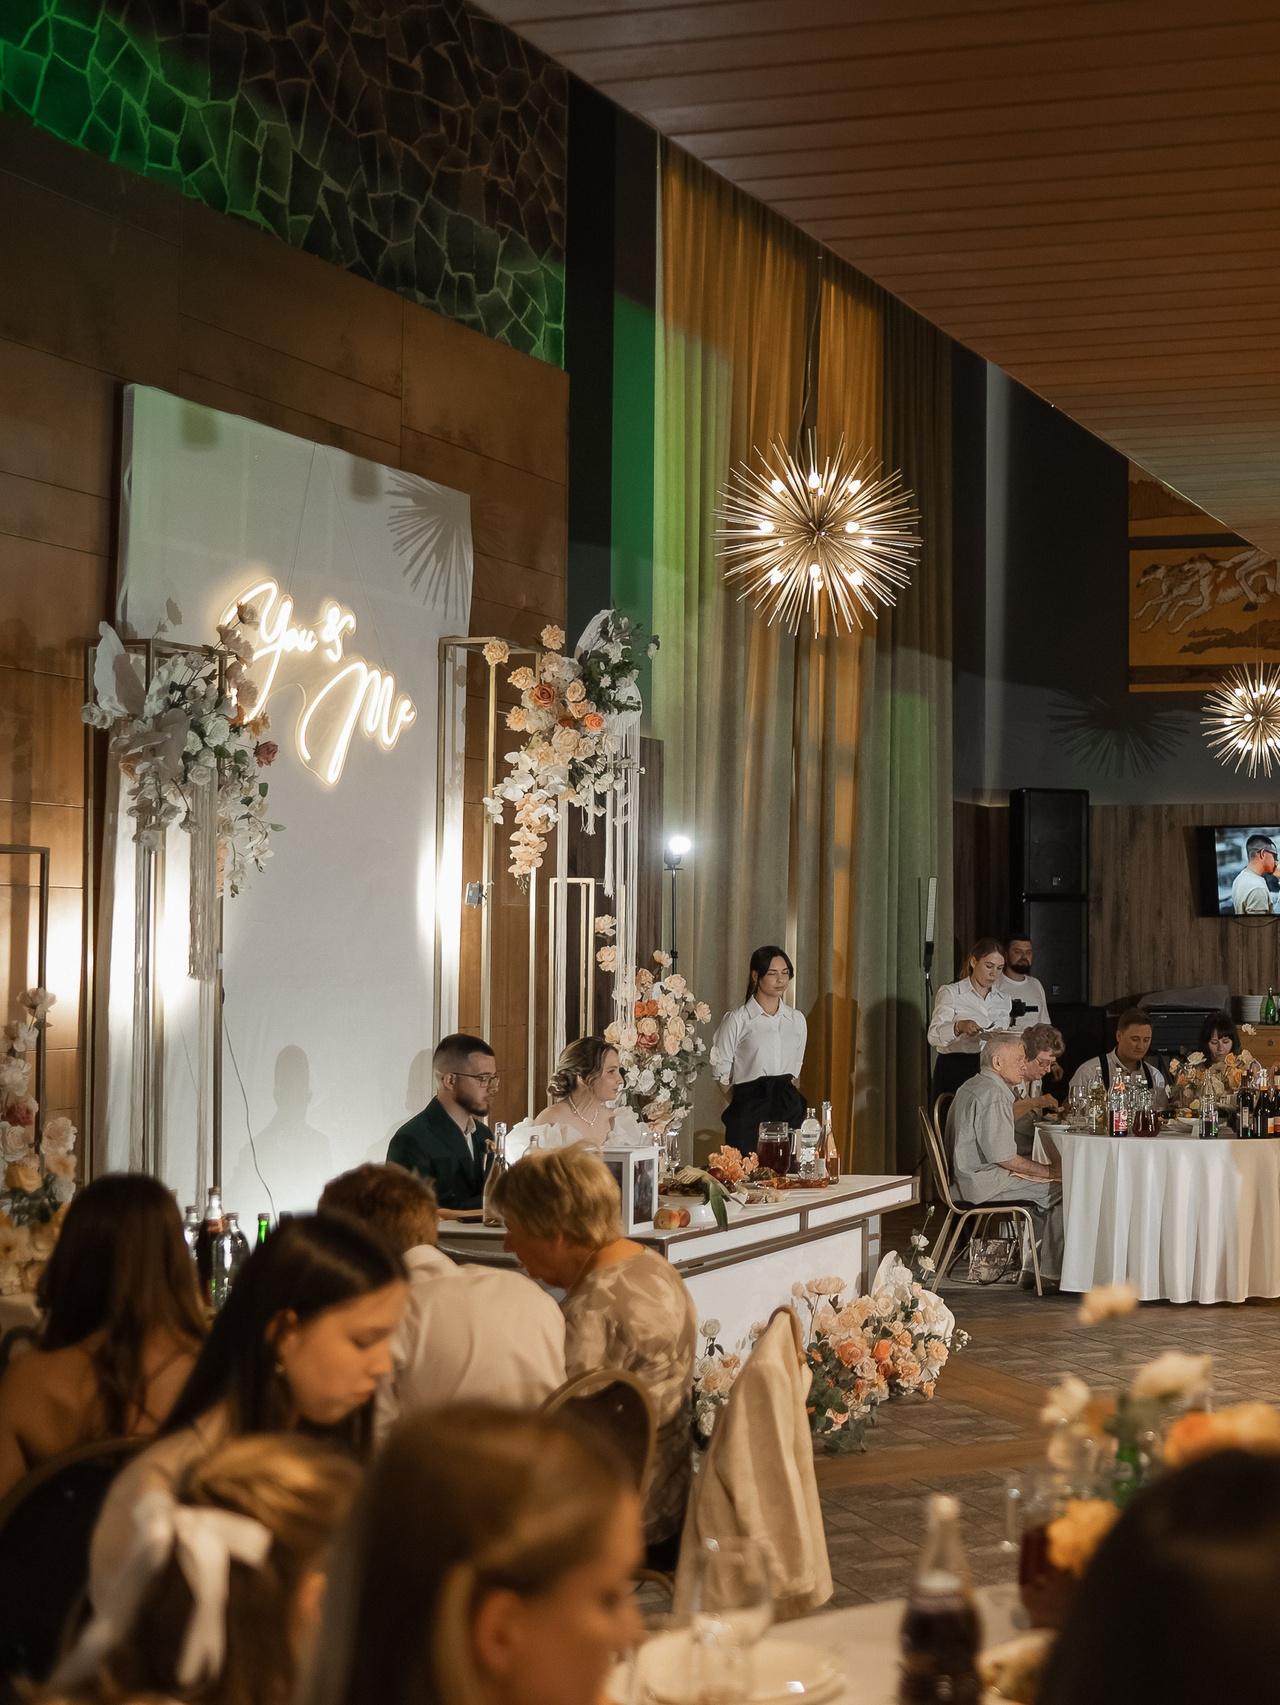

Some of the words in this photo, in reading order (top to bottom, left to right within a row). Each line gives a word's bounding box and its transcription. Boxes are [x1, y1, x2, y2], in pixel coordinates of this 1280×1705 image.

[219, 580, 318, 725] You
[321, 605, 356, 662] &
[300, 661, 416, 785] Me
